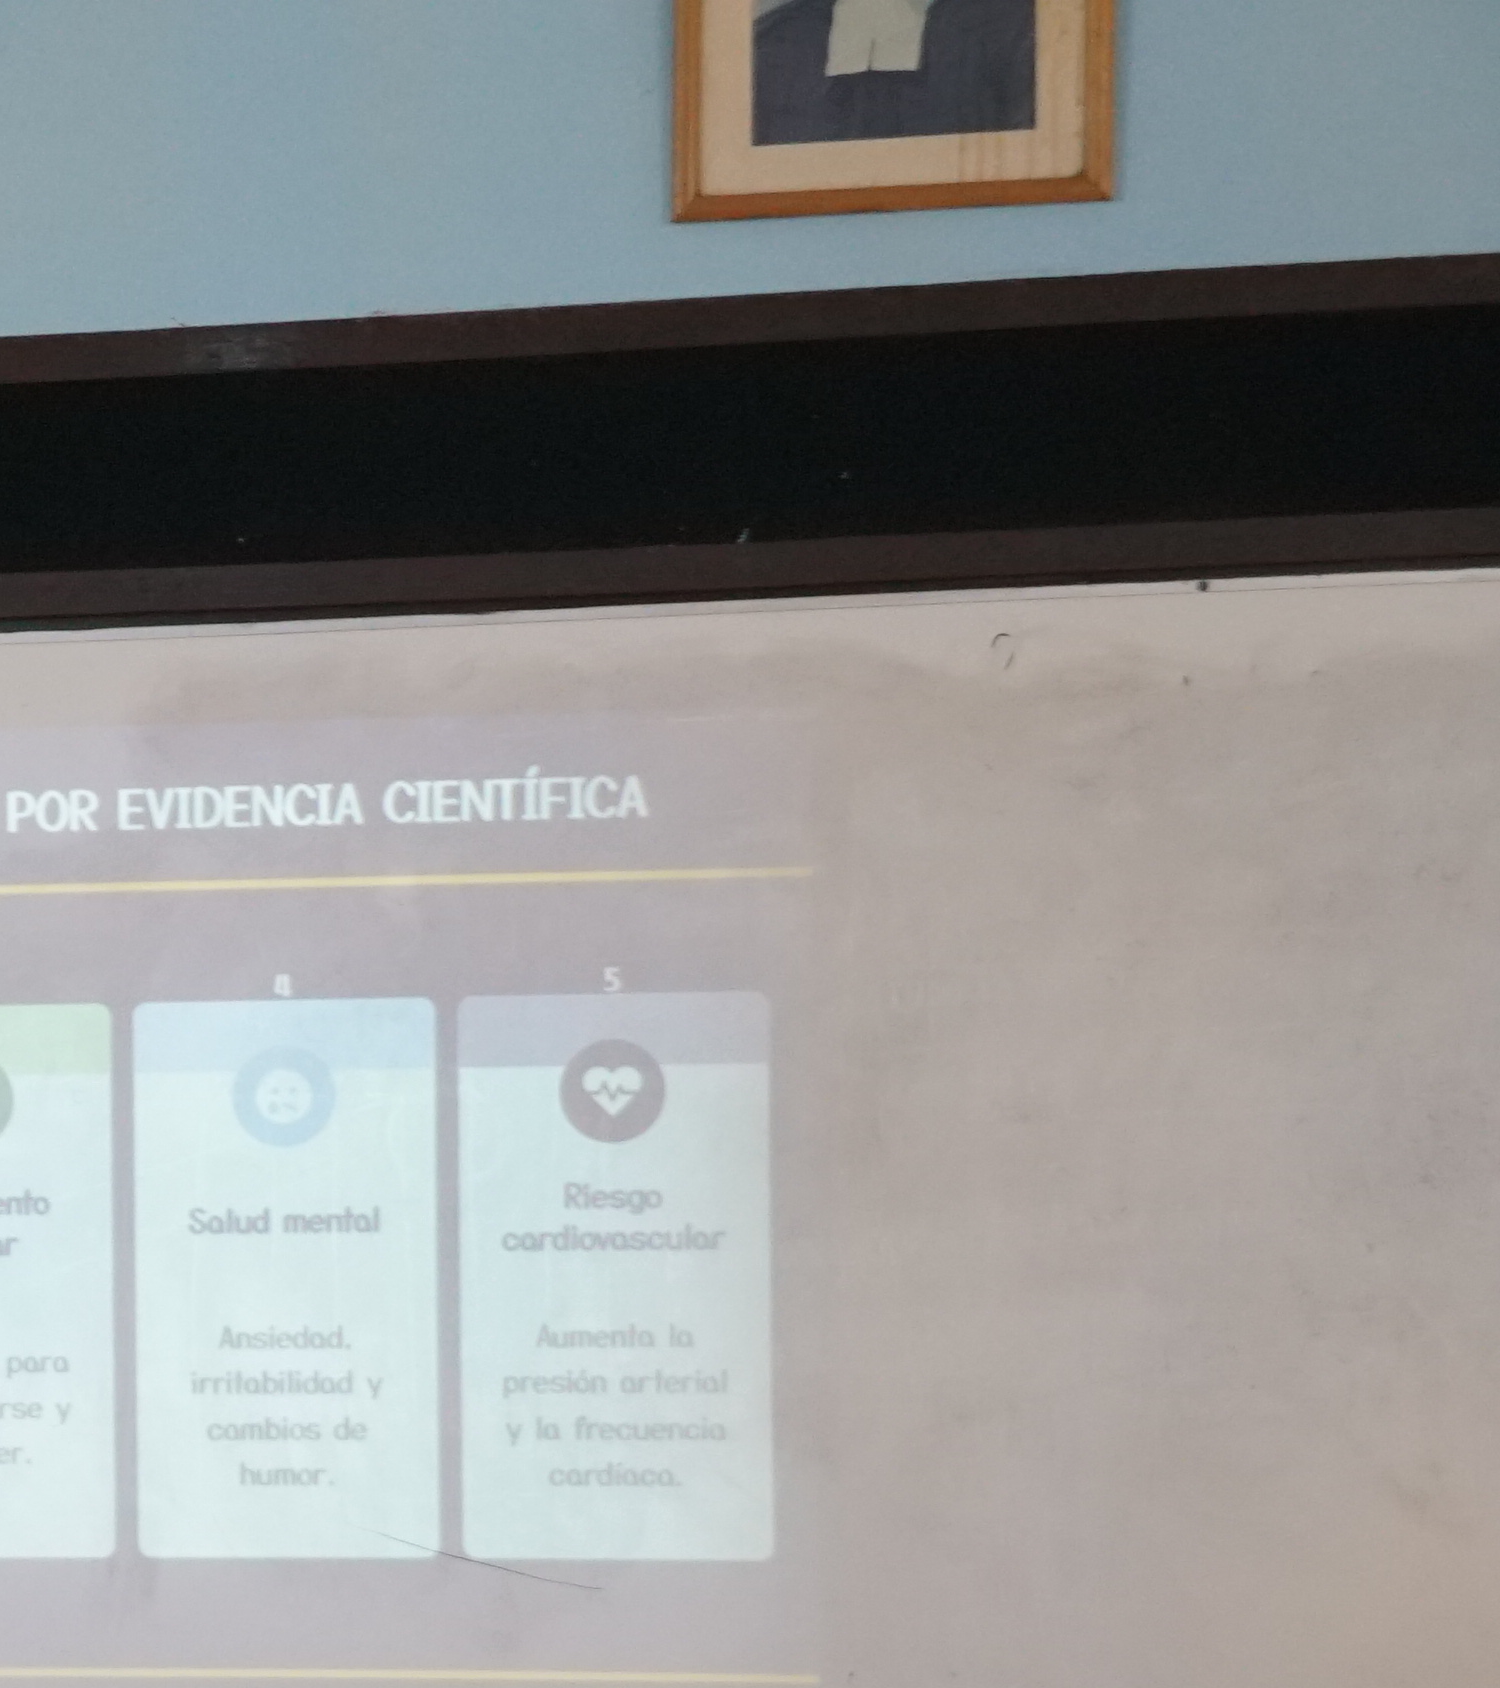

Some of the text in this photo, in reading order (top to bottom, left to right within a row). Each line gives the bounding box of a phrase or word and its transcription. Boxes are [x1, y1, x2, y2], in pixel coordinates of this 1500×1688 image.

[5, 788, 99, 833] POR
[117, 781, 365, 831] EVIDENCIA
[382, 764, 649, 824] CIENTÍFICA
[272, 973, 295, 998] 4
[602, 965, 623, 993] 5
[562, 1181, 665, 1215] Riesgo
[187, 1205, 381, 1235] Salud mental
[500, 1222, 728, 1253] cardiovascular
[535, 1322, 696, 1349] Aumenta la
[6, 1354, 71, 1380] para
[190, 1369, 385, 1400] irritabilidad y
[501, 1367, 730, 1399] presión arterial
[55, 1401, 73, 1426] y
[205, 1415, 369, 1442] cambios de
[504, 1414, 728, 1448] y la frecuencia
[239, 1461, 337, 1487] humor.
